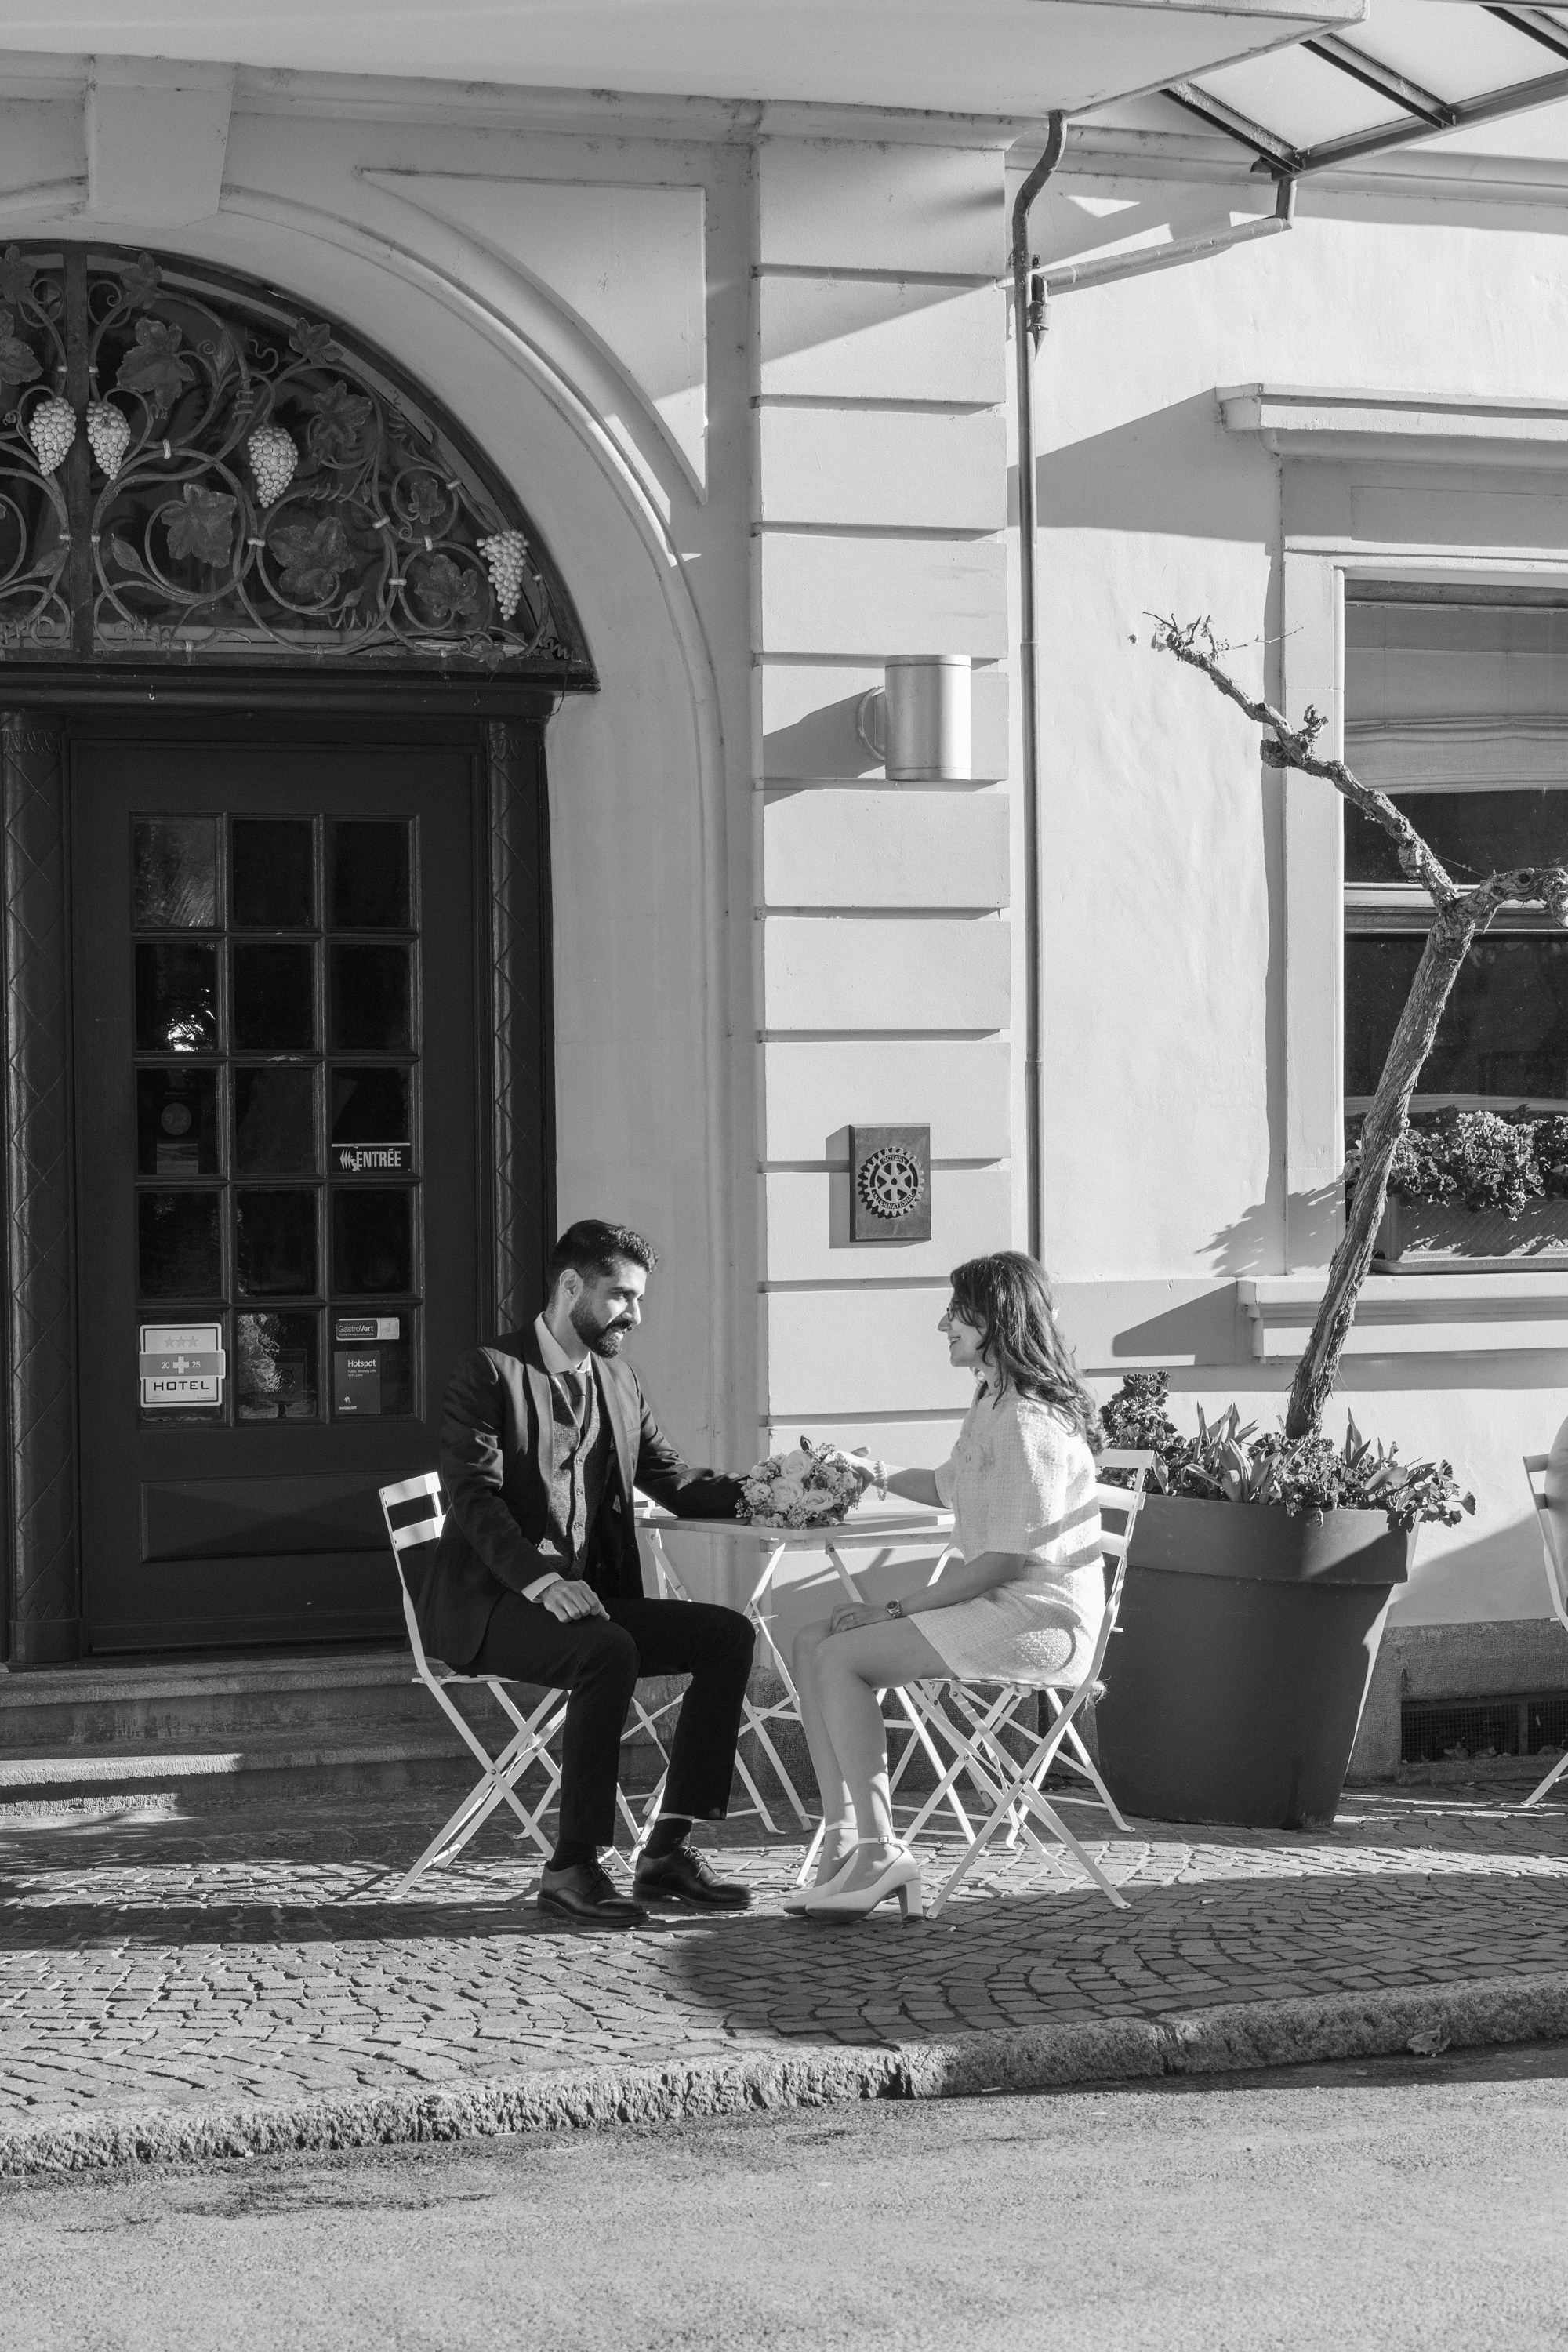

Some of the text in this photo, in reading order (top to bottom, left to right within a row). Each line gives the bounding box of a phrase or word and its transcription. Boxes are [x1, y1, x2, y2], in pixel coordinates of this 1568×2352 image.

[356, 1148, 401, 1167] ENTRÉE
[882, 1155, 907, 1164] ROTARY
[872, 1192, 915, 1209] INTERNATIONAL
[347, 1359, 376, 1369] Hotspot
[154, 1381, 209, 1391] HOTEL
